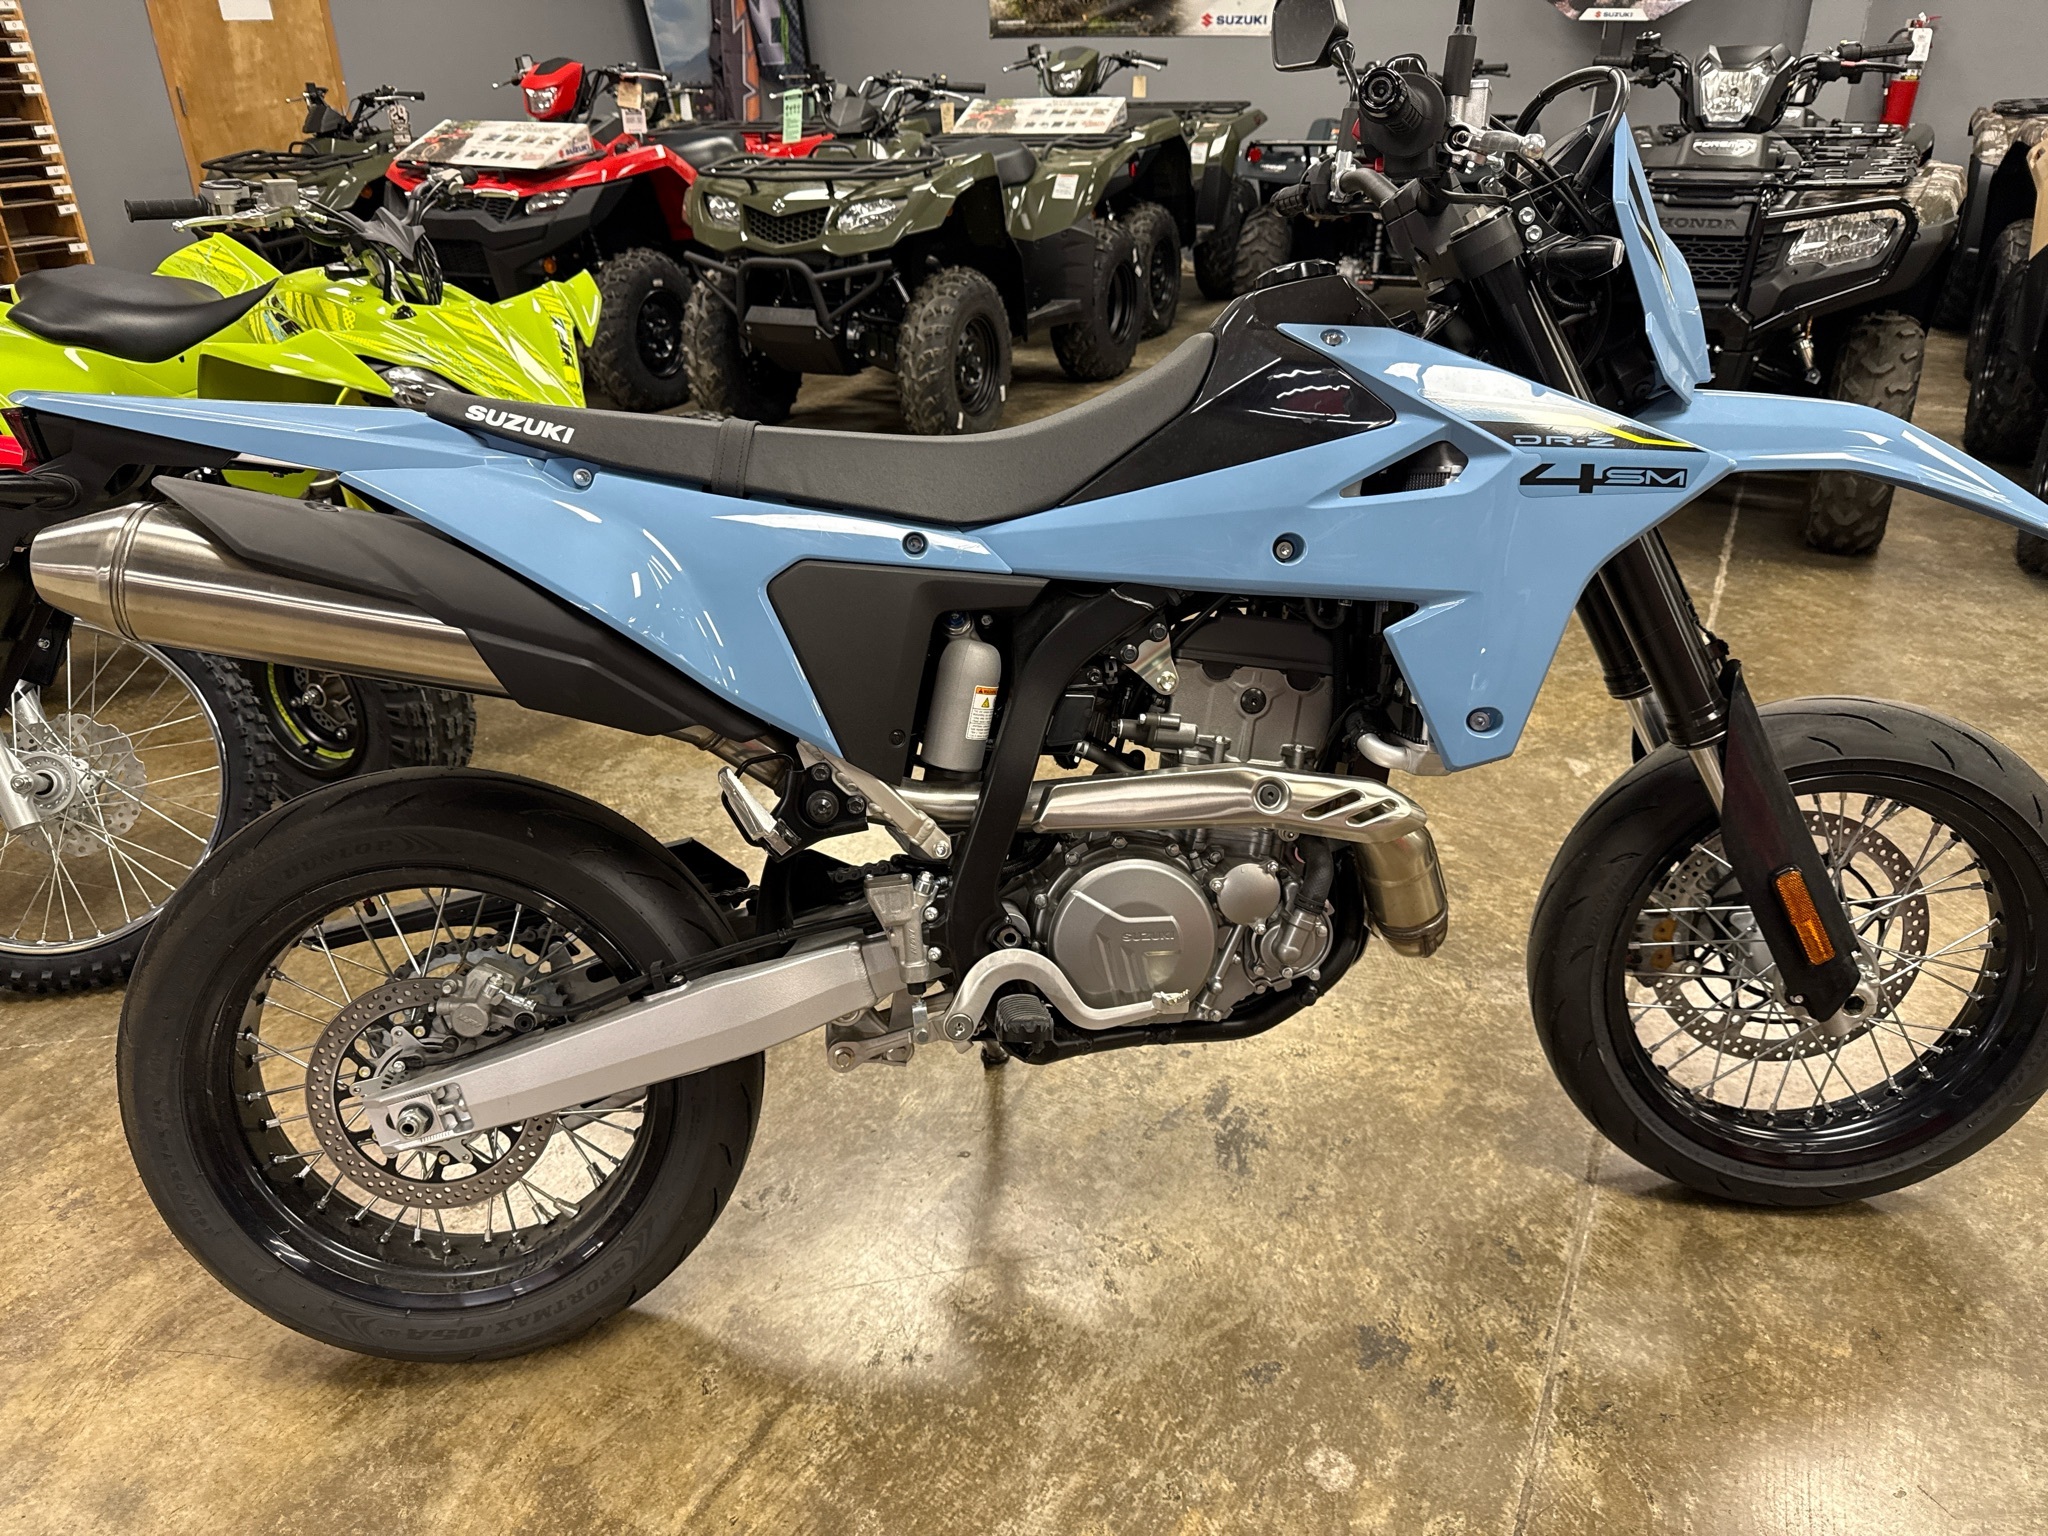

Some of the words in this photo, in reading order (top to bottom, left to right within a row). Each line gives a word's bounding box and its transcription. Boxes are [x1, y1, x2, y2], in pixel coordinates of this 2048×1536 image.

[1216, 15, 1267, 25] SUZUKI
[1660, 217, 1741, 230] HONDA
[465, 405, 575, 444] SUZUKI
[1513, 435, 1615, 447] DR-Z
[1123, 931, 1175, 941] SUZUKI
[495, 1256, 627, 1335] SPORTMAX
